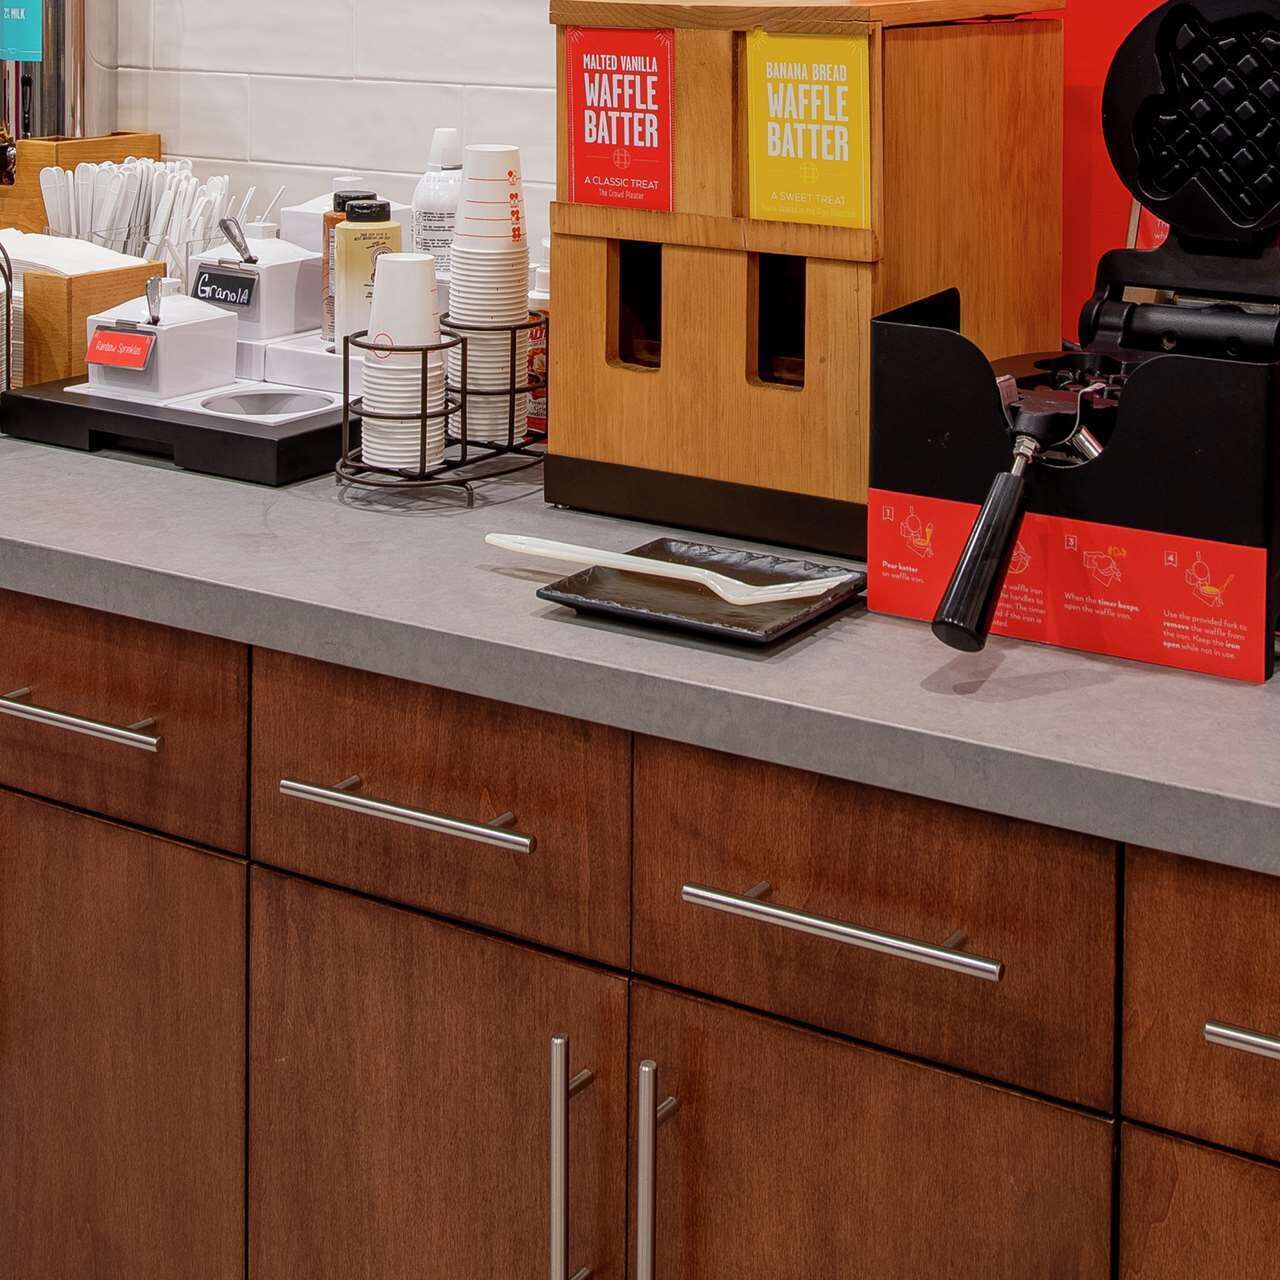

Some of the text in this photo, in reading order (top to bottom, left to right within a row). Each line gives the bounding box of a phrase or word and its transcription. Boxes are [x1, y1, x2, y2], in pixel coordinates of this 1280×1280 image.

[11, 8, 26, 20] MILK
[583, 54, 658, 72] MALTED VANILLA
[766, 62, 847, 82] BANANA BREAD
[583, 72, 658, 110] WAFFLE
[767, 82, 849, 122] WAFFLE
[584, 109, 658, 148] BATTER
[767, 121, 849, 161] BATTER
[584, 175, 659, 190] A CLASSIC TREAT
[770, 191, 847, 206] A SWEET TREAT
[882, 560, 918, 573] Pour batter
[1008, 584, 1029, 593] waffle
[1010, 592, 1035, 603] handles
[1064, 592, 1084, 602] When
[1085, 595, 1097, 604] the
[1098, 598, 1117, 608] timer
[1081, 605, 1093, 614] the
[1094, 607, 1116, 618] waffle
[1163, 610, 1177, 619] Use
[1179, 611, 1190, 621] the
[1192, 616, 1222, 627] provided
[1224, 620, 1237, 629] fork
[1163, 621, 1245, 641] remove the waffle from
[1163, 641, 1180, 649] open
[1193, 634, 1211, 645] Keep
[1226, 640, 1241, 650] iron
